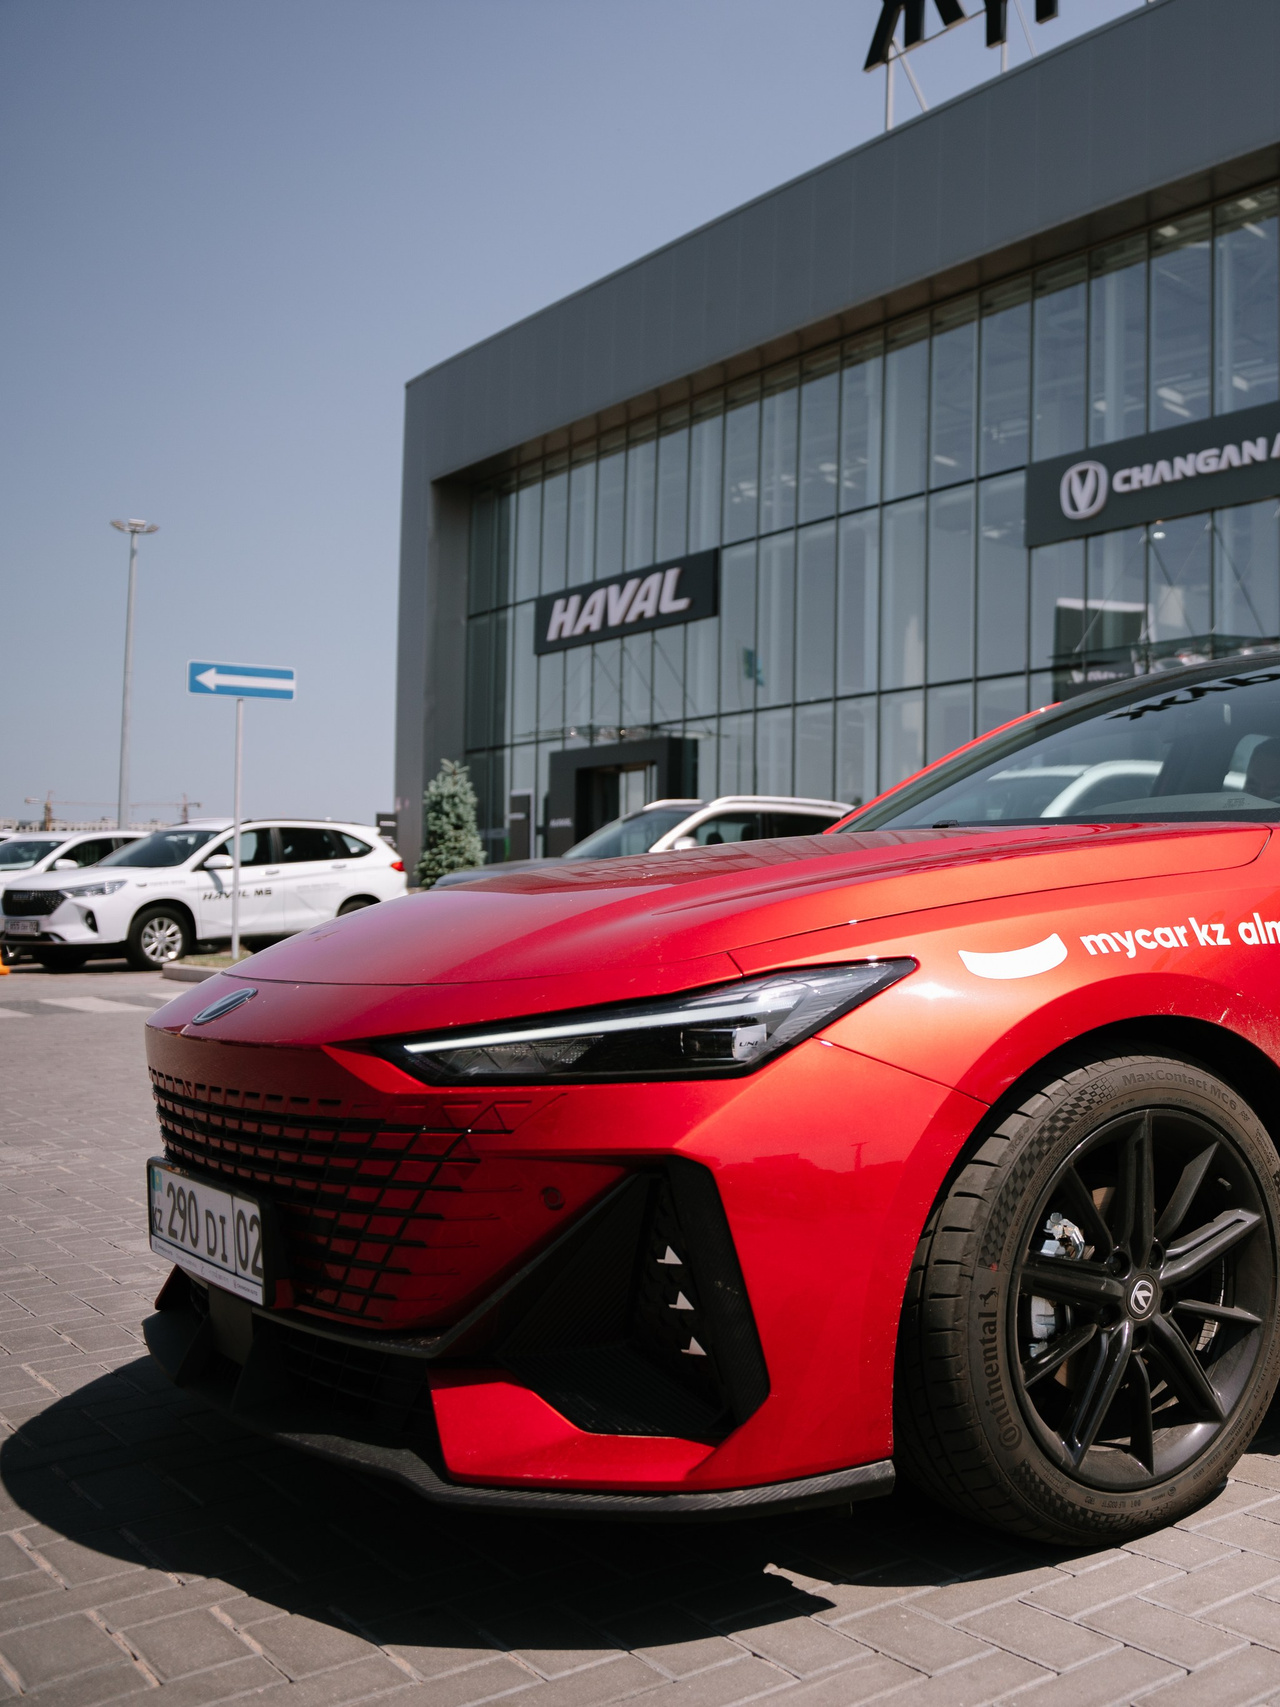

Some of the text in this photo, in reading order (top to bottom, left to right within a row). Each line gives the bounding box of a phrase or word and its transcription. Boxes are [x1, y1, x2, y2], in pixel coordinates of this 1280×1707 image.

[1112, 437, 1268, 493] CHANGAN
[546, 566, 692, 642] HAVAL
[202, 891, 250, 901] HAVL
[1080, 925, 1189, 959] mycar
[1188, 917, 1231, 946] kz
[1121, 1069, 1208, 1092] MaxContact
[1210, 1083, 1238, 1111] MC6
[167, 1181, 263, 1280] 290 DI 02
[978, 1310, 1023, 1450] Continental
